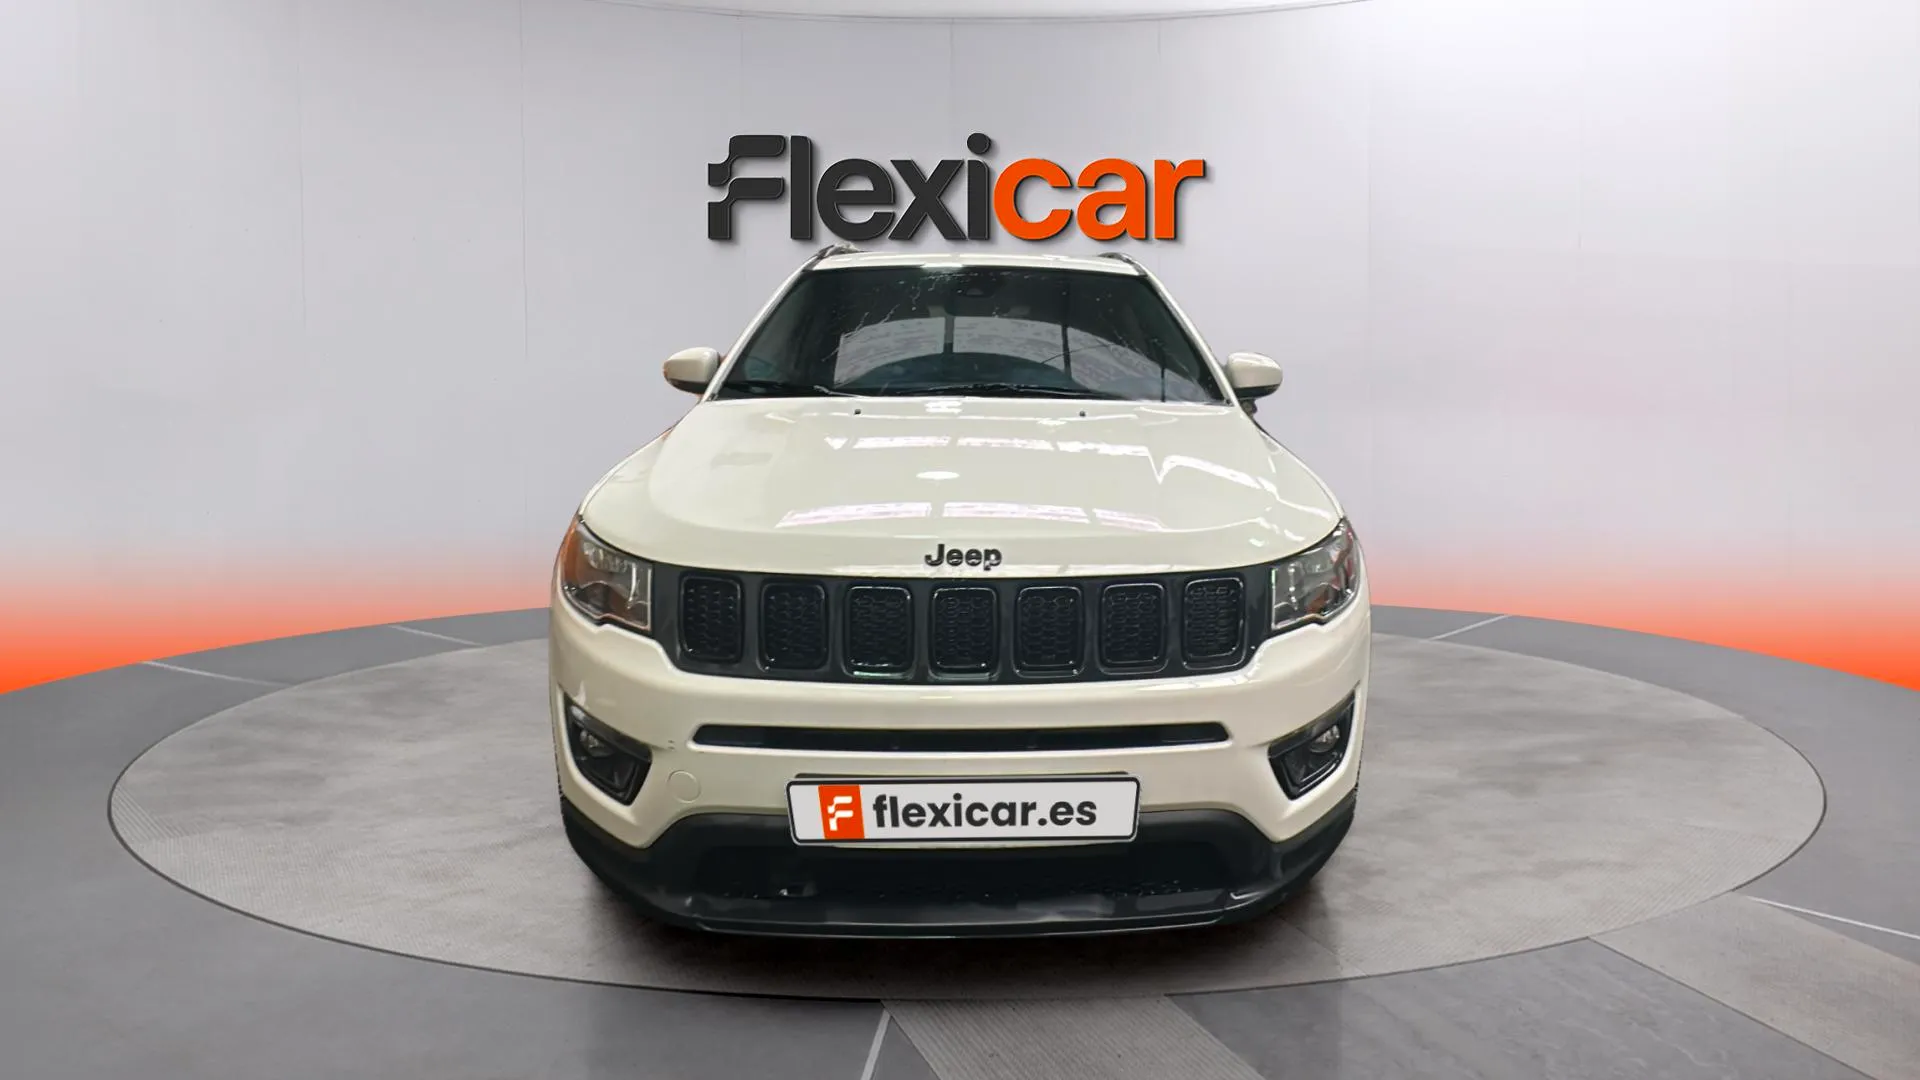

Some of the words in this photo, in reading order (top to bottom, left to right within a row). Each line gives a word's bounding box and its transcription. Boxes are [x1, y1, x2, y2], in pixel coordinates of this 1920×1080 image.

[708, 133, 1205, 240] Flexicar
[924, 543, 1002, 571] Jeep
[872, 792, 1098, 828] flexicar.es
